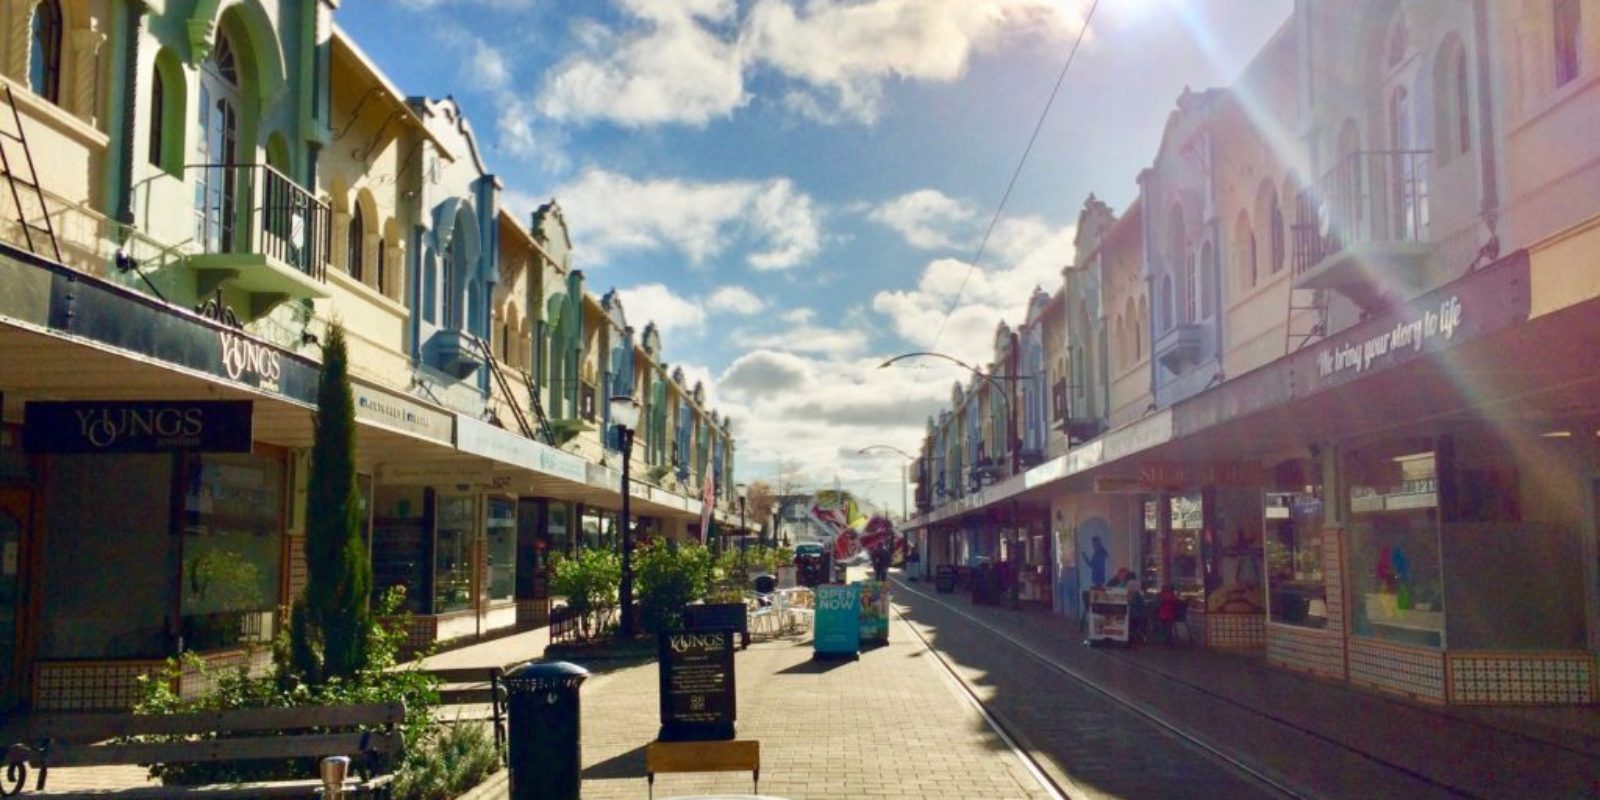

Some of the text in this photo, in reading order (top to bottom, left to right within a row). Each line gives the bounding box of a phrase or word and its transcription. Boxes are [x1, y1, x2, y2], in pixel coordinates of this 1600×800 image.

[1316, 296, 1462, 377] We bring your story to life
[219, 331, 281, 380] YOUNGS
[74, 407, 203, 447] YOUNGS
[818, 587, 857, 600] OPEN
[819, 599, 855, 611] NOW
[669, 633, 725, 652] YOUNGS
